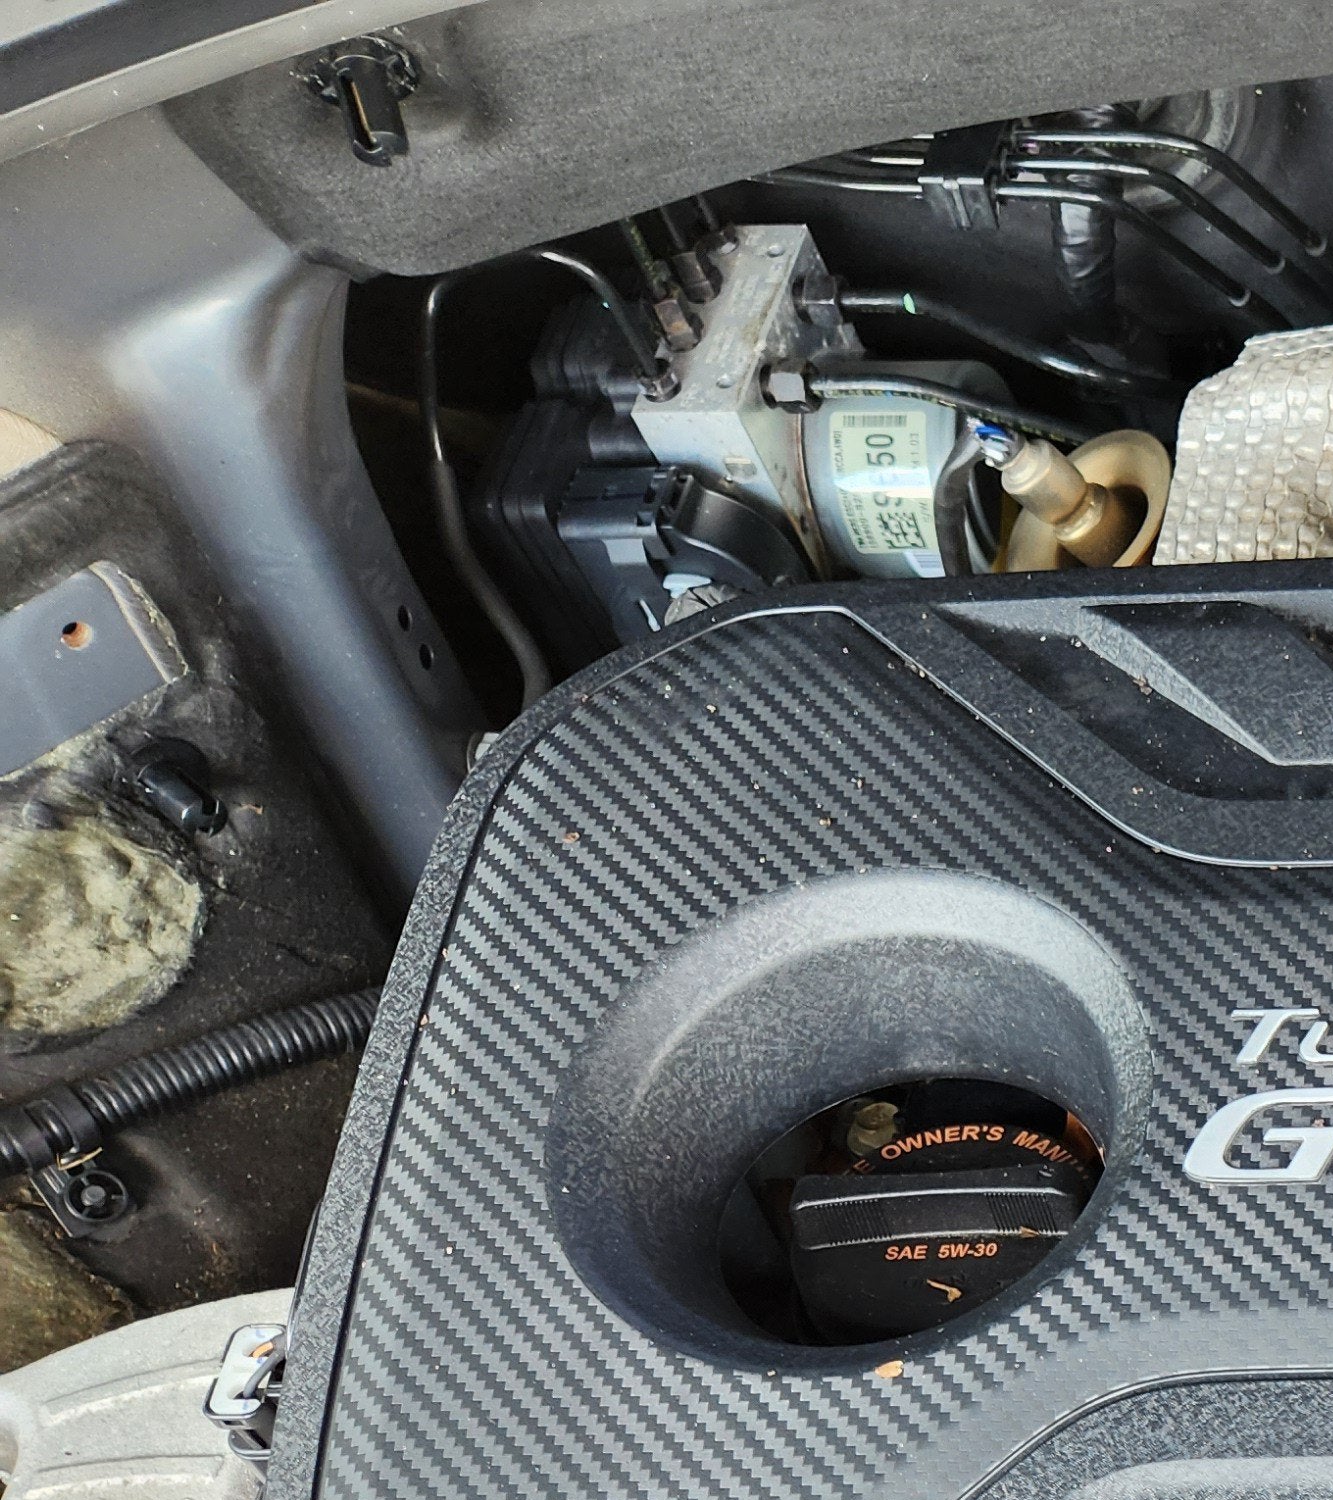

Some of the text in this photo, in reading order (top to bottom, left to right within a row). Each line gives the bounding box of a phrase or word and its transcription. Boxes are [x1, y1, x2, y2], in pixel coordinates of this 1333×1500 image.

[880, 1124, 1005, 1160] OWNER'S
[884, 1242, 999, 1262] SAE 5W-30
